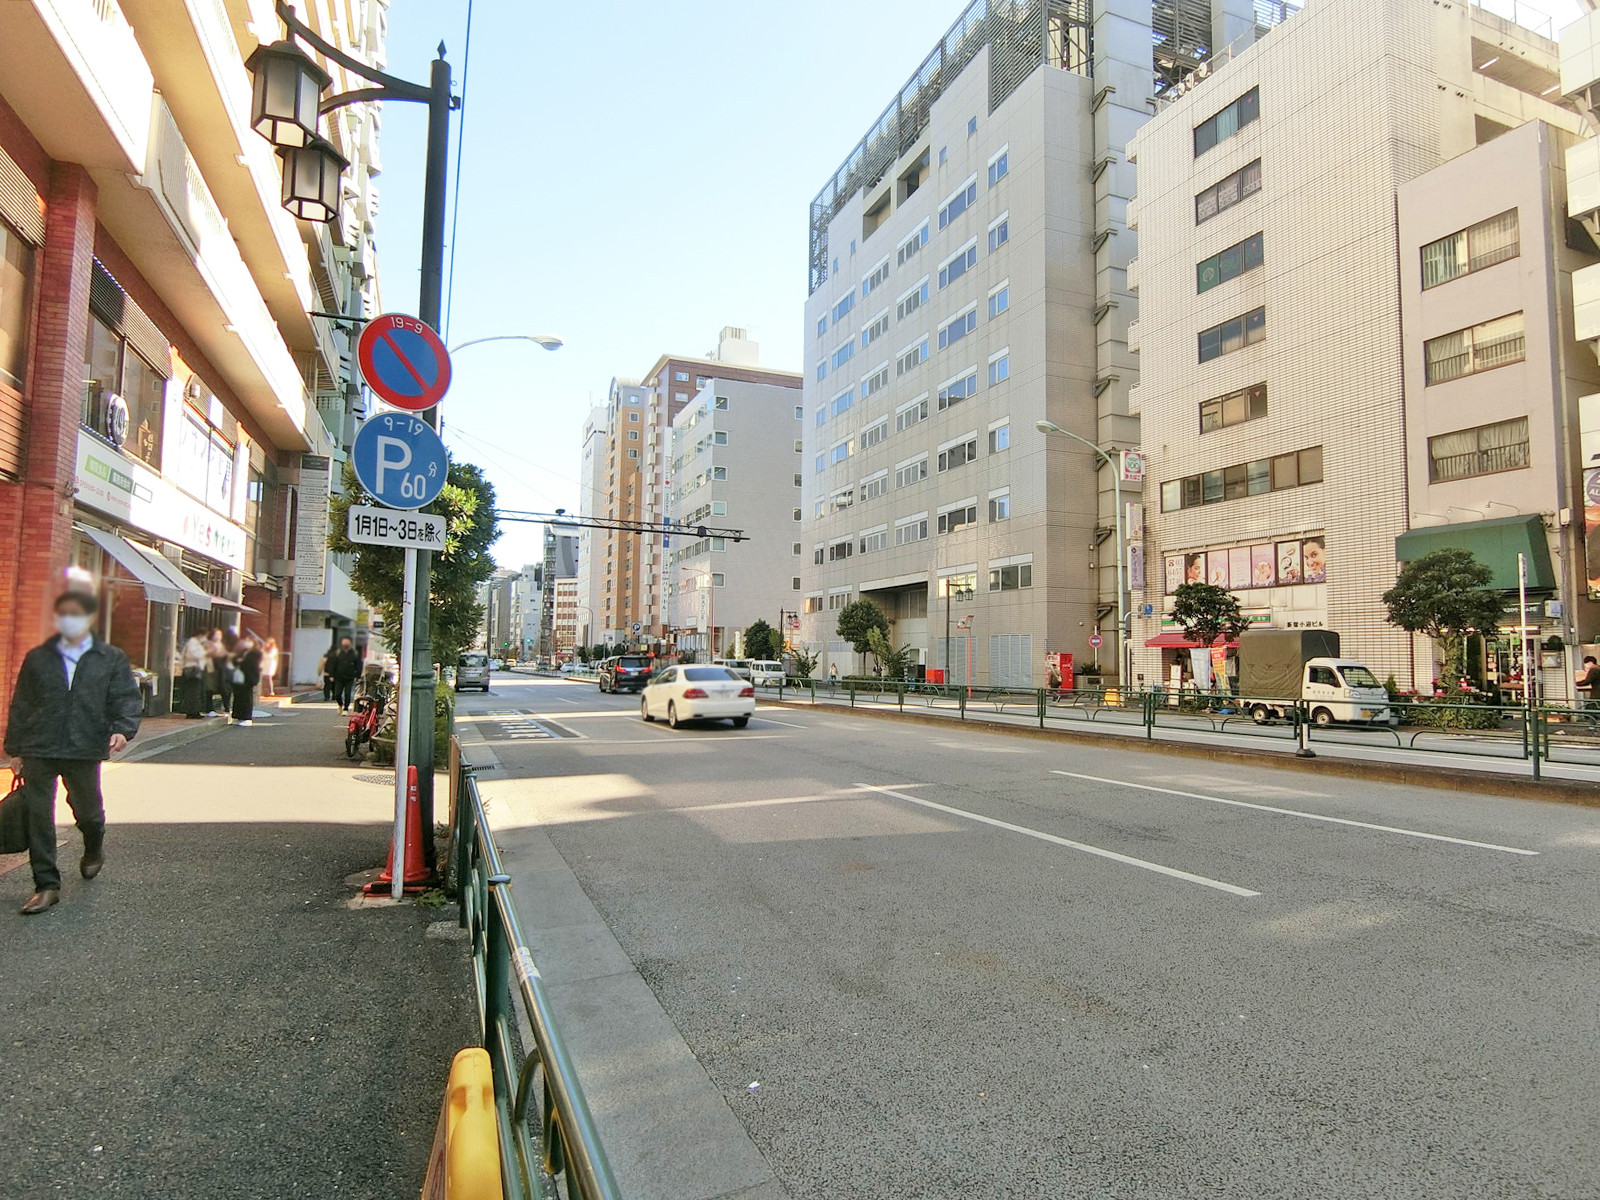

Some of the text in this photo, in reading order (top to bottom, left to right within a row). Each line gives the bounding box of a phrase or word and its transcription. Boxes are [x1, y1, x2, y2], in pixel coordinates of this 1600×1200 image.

[391, 316, 424, 335] 19-9
[383, 416, 424, 436] 9-19
[375, 435, 427, 500] P 60
[428, 461, 438, 478] 分
